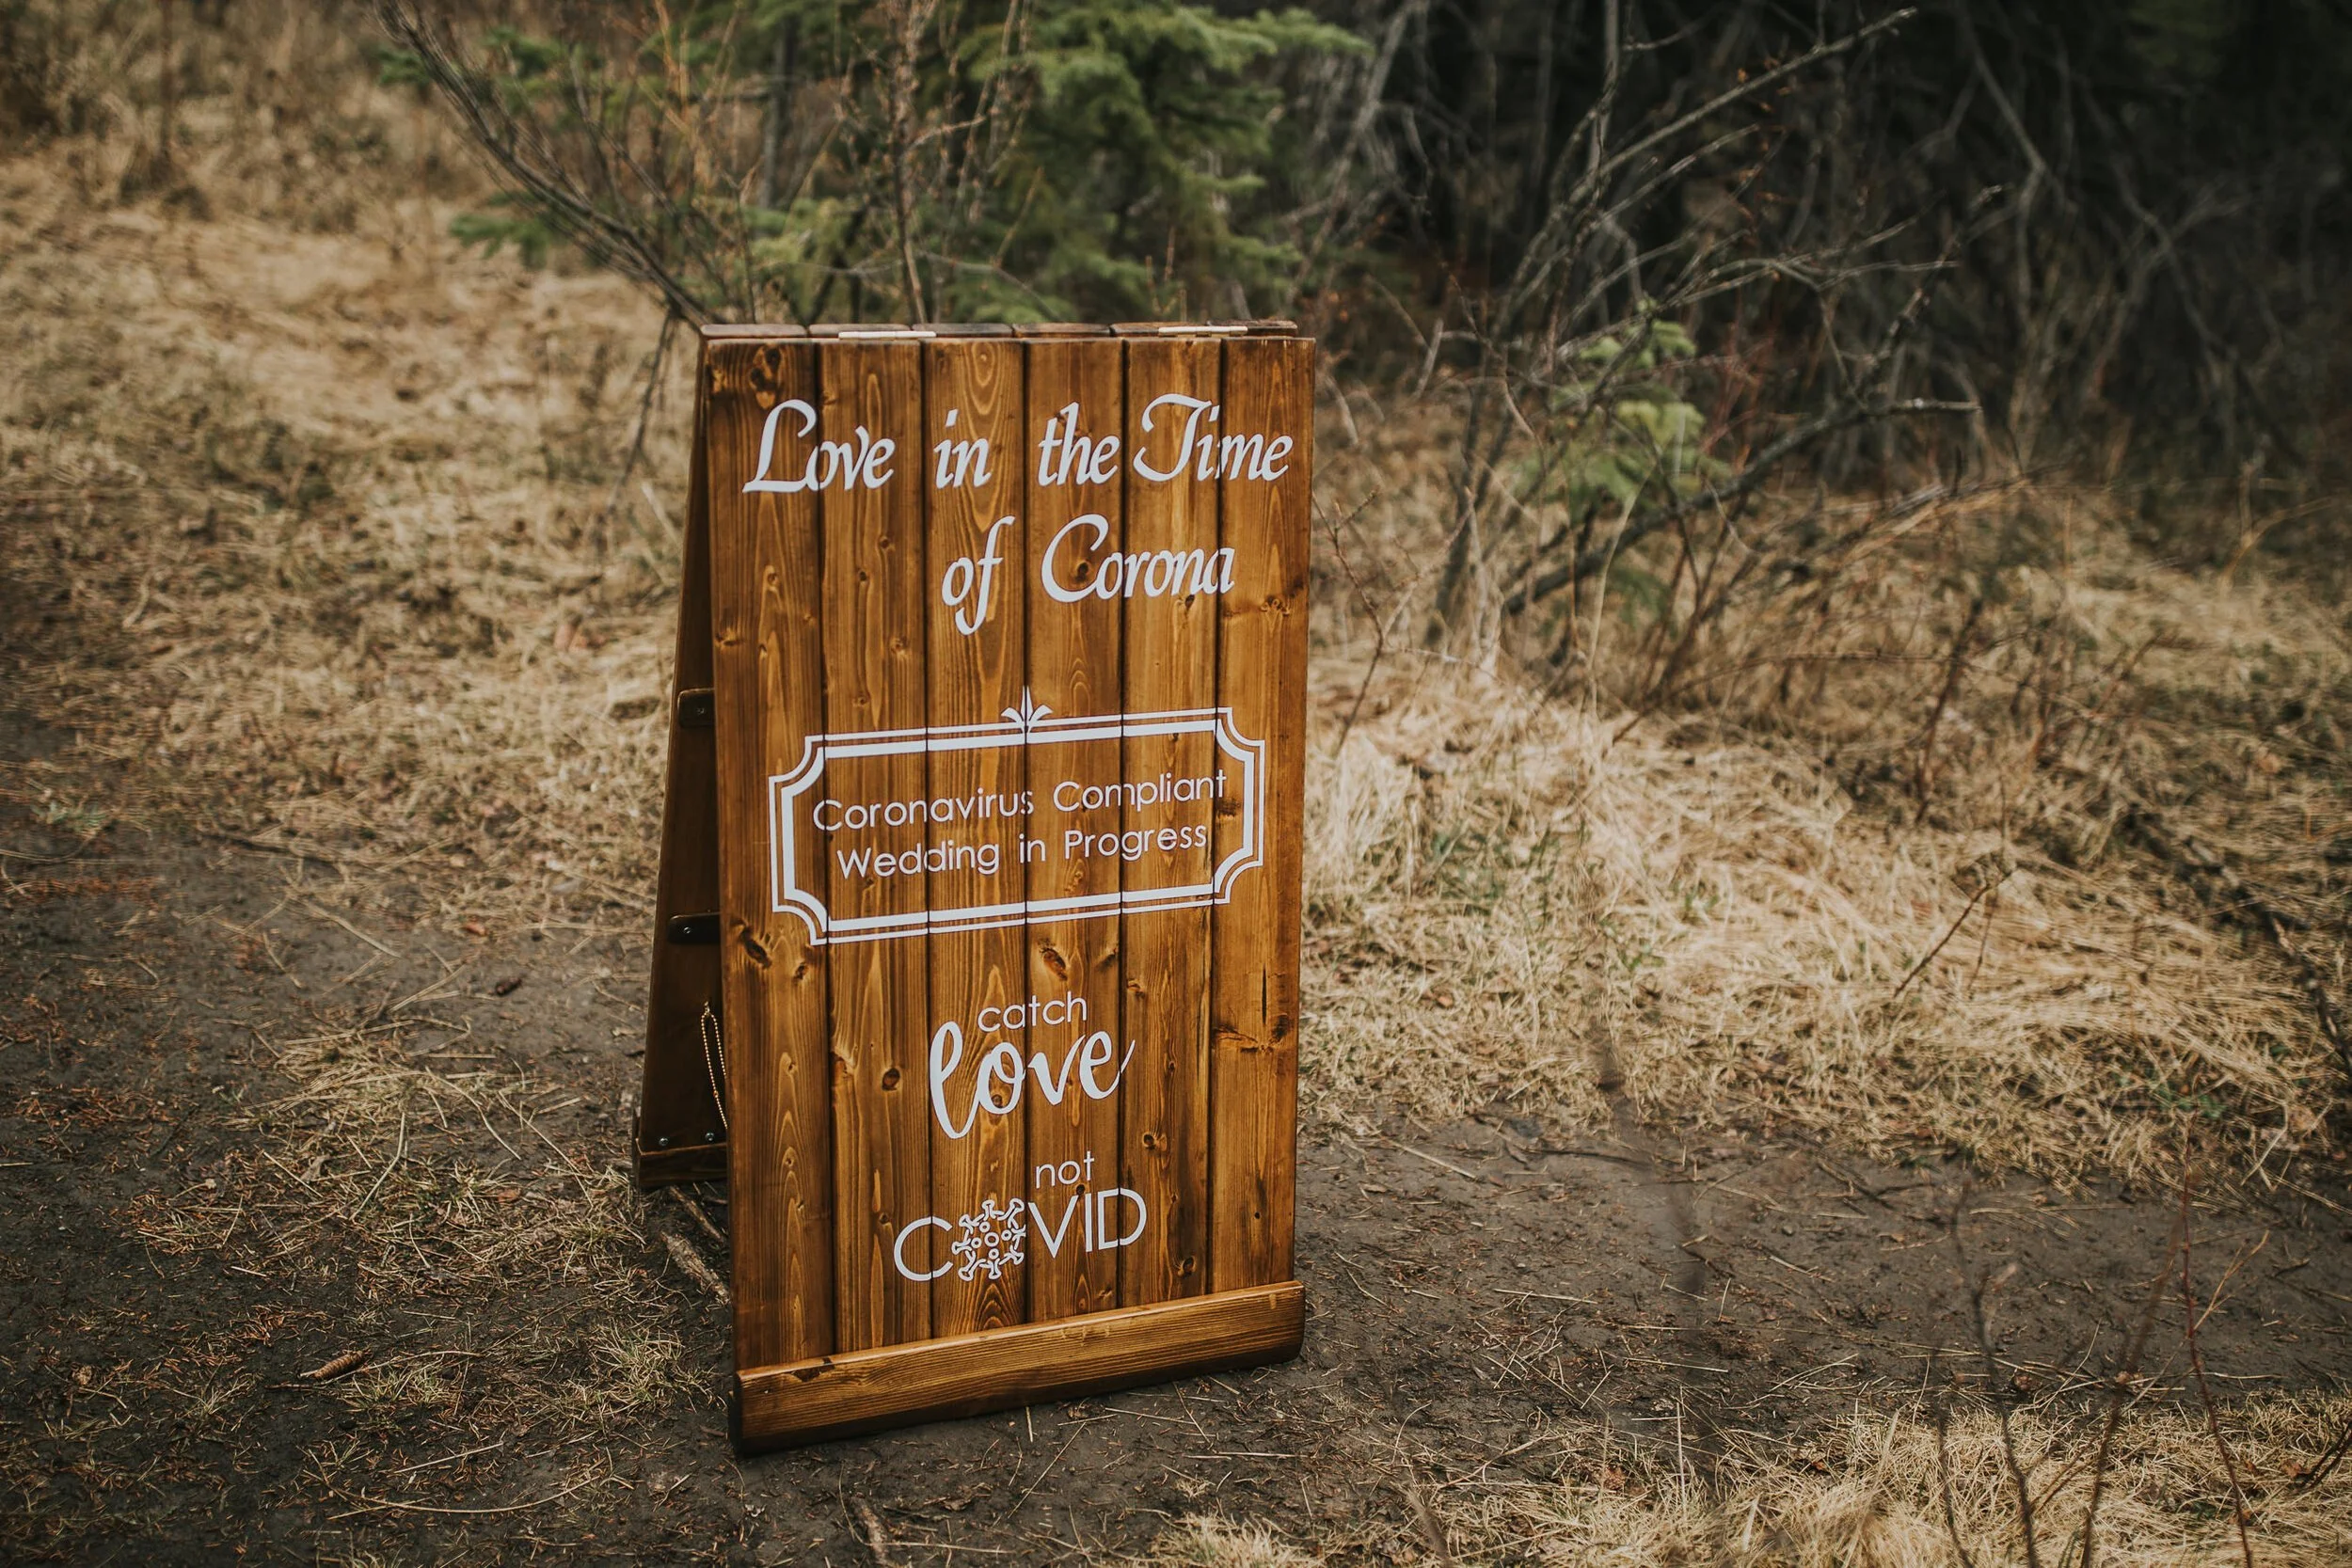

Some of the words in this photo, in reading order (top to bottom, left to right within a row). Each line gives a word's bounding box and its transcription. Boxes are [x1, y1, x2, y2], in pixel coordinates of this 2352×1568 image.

[742, 400, 896, 494] Love
[932, 408, 993, 490] in
[1038, 402, 1120, 487] the
[1133, 393, 1294, 483] Time
[941, 515, 1016, 636] of
[1041, 514, 1235, 603] Corona
[812, 789, 1035, 832] Coronavirus
[1053, 768, 1227, 813] Compliant
[836, 839, 1000, 879] Wedding
[1019, 834, 1046, 864] in
[1064, 822, 1208, 862] Progress
[977, 990, 1088, 1033] catch
[930, 1021, 1136, 1140] love
[1035, 1150, 1095, 1189] not
